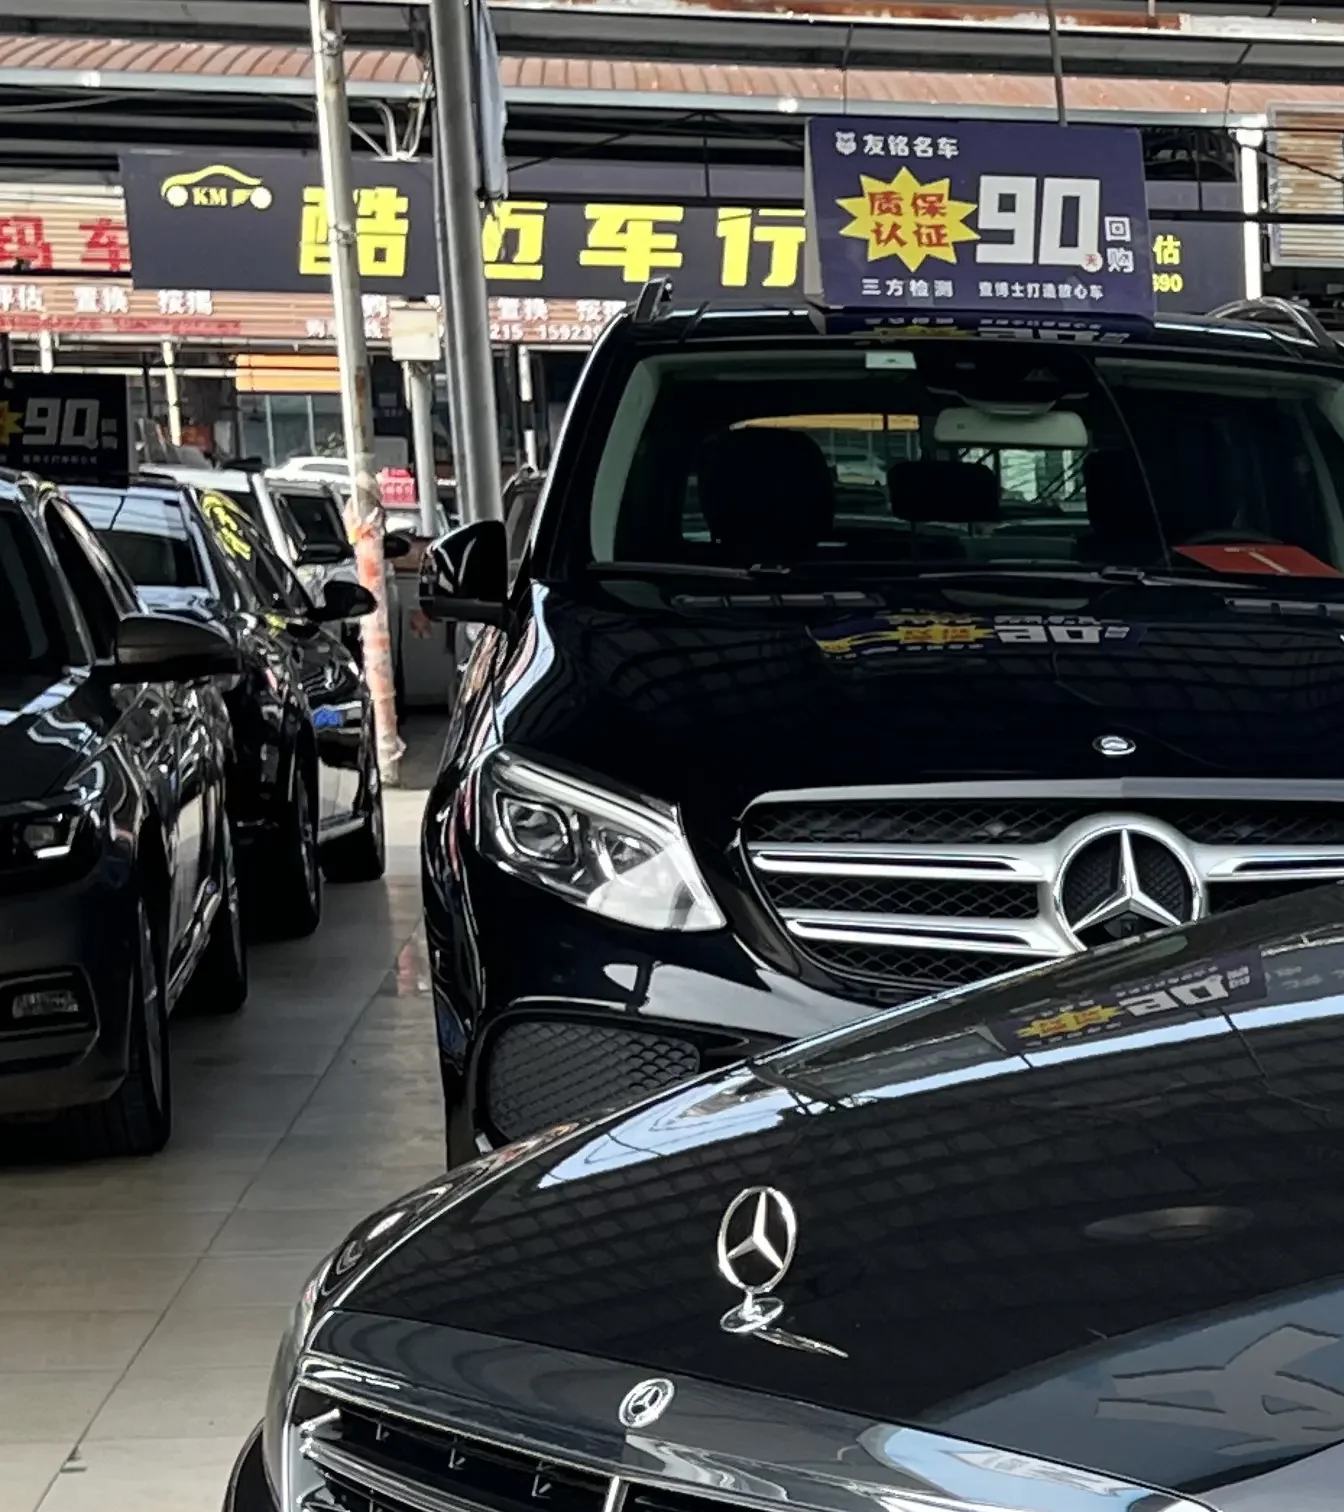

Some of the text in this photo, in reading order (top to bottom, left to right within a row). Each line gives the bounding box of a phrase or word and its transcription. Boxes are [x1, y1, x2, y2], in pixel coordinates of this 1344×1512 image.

[863, 134, 960, 159] 友铭名车
[191, 188, 228, 207] KM
[867, 191, 948, 218] 质保
[975, 174, 1100, 265] 90
[871, 222, 950, 249] 认证
[1104, 216, 1135, 274] 回购
[861, 278, 954, 299] 三方检测
[22, 397, 101, 449] 90
